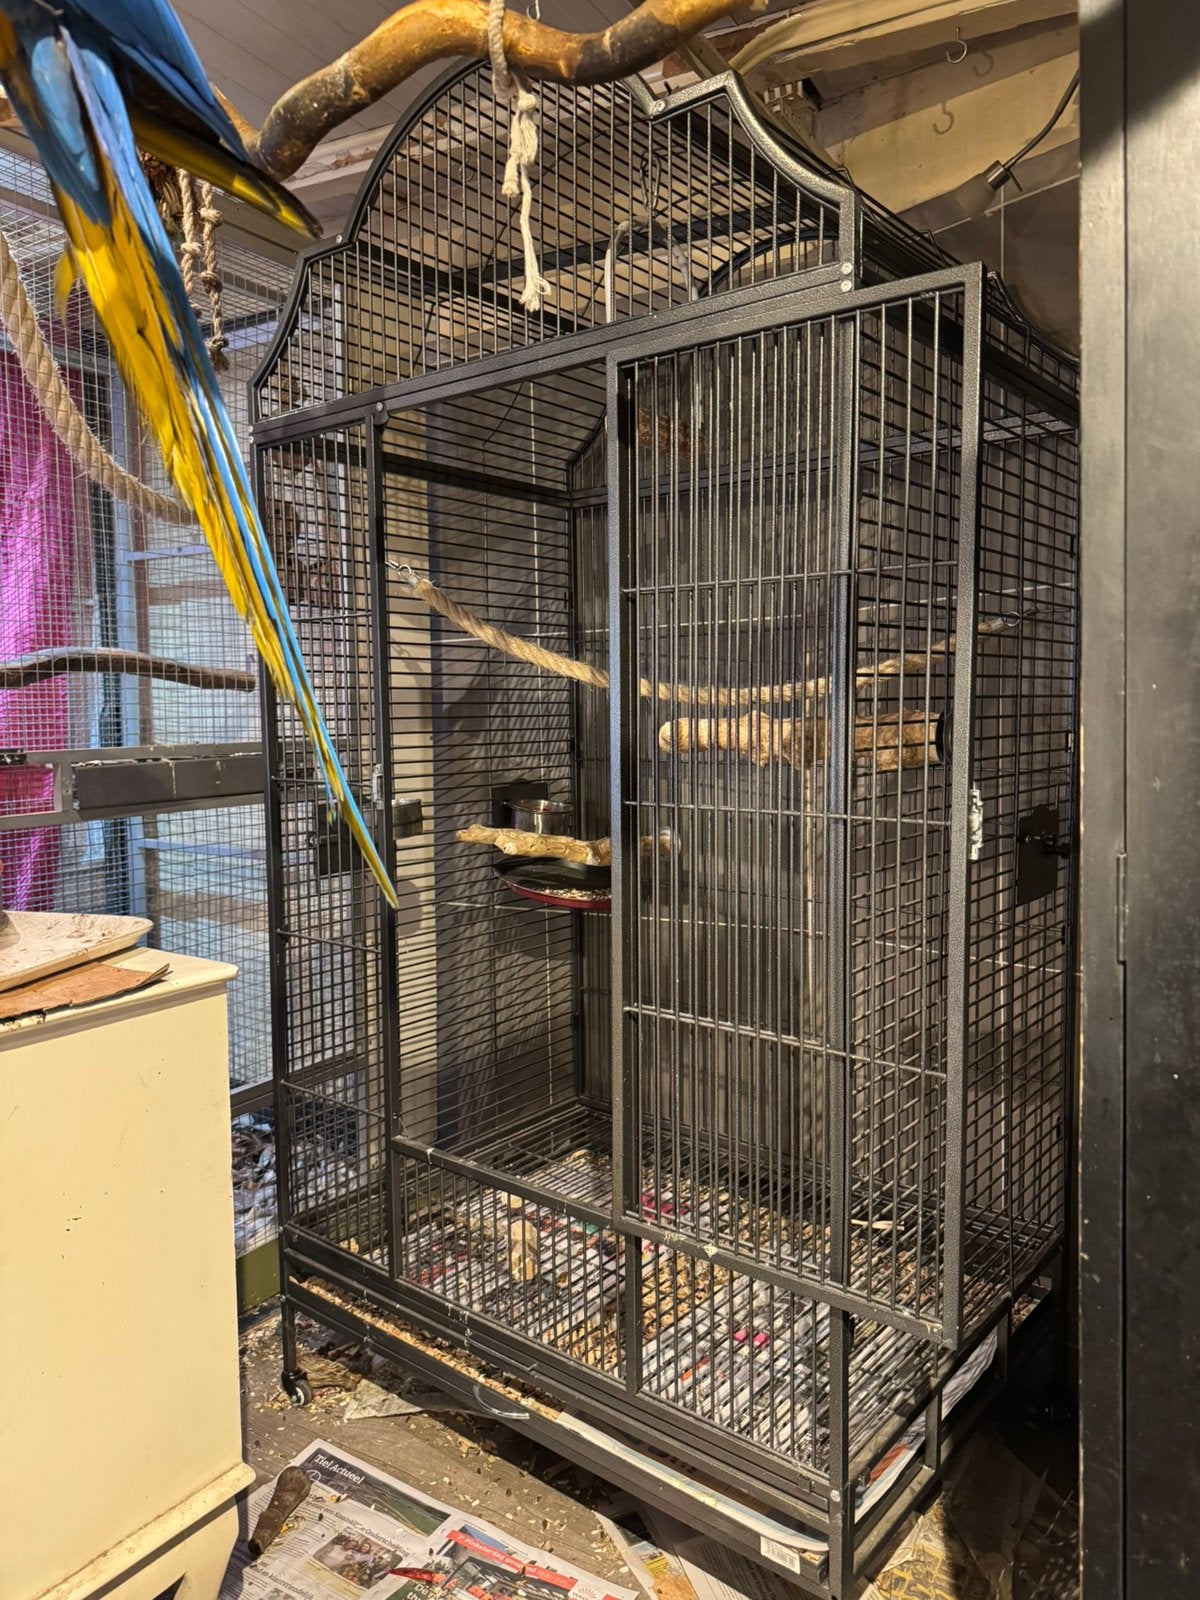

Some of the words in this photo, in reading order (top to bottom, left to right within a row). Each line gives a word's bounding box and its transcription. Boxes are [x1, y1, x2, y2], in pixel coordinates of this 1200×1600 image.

[314, 1454, 334, 1469] Tiel
[330, 1463, 366, 1485] Actueel
[464, 1536, 506, 1562] Pinksterdag
